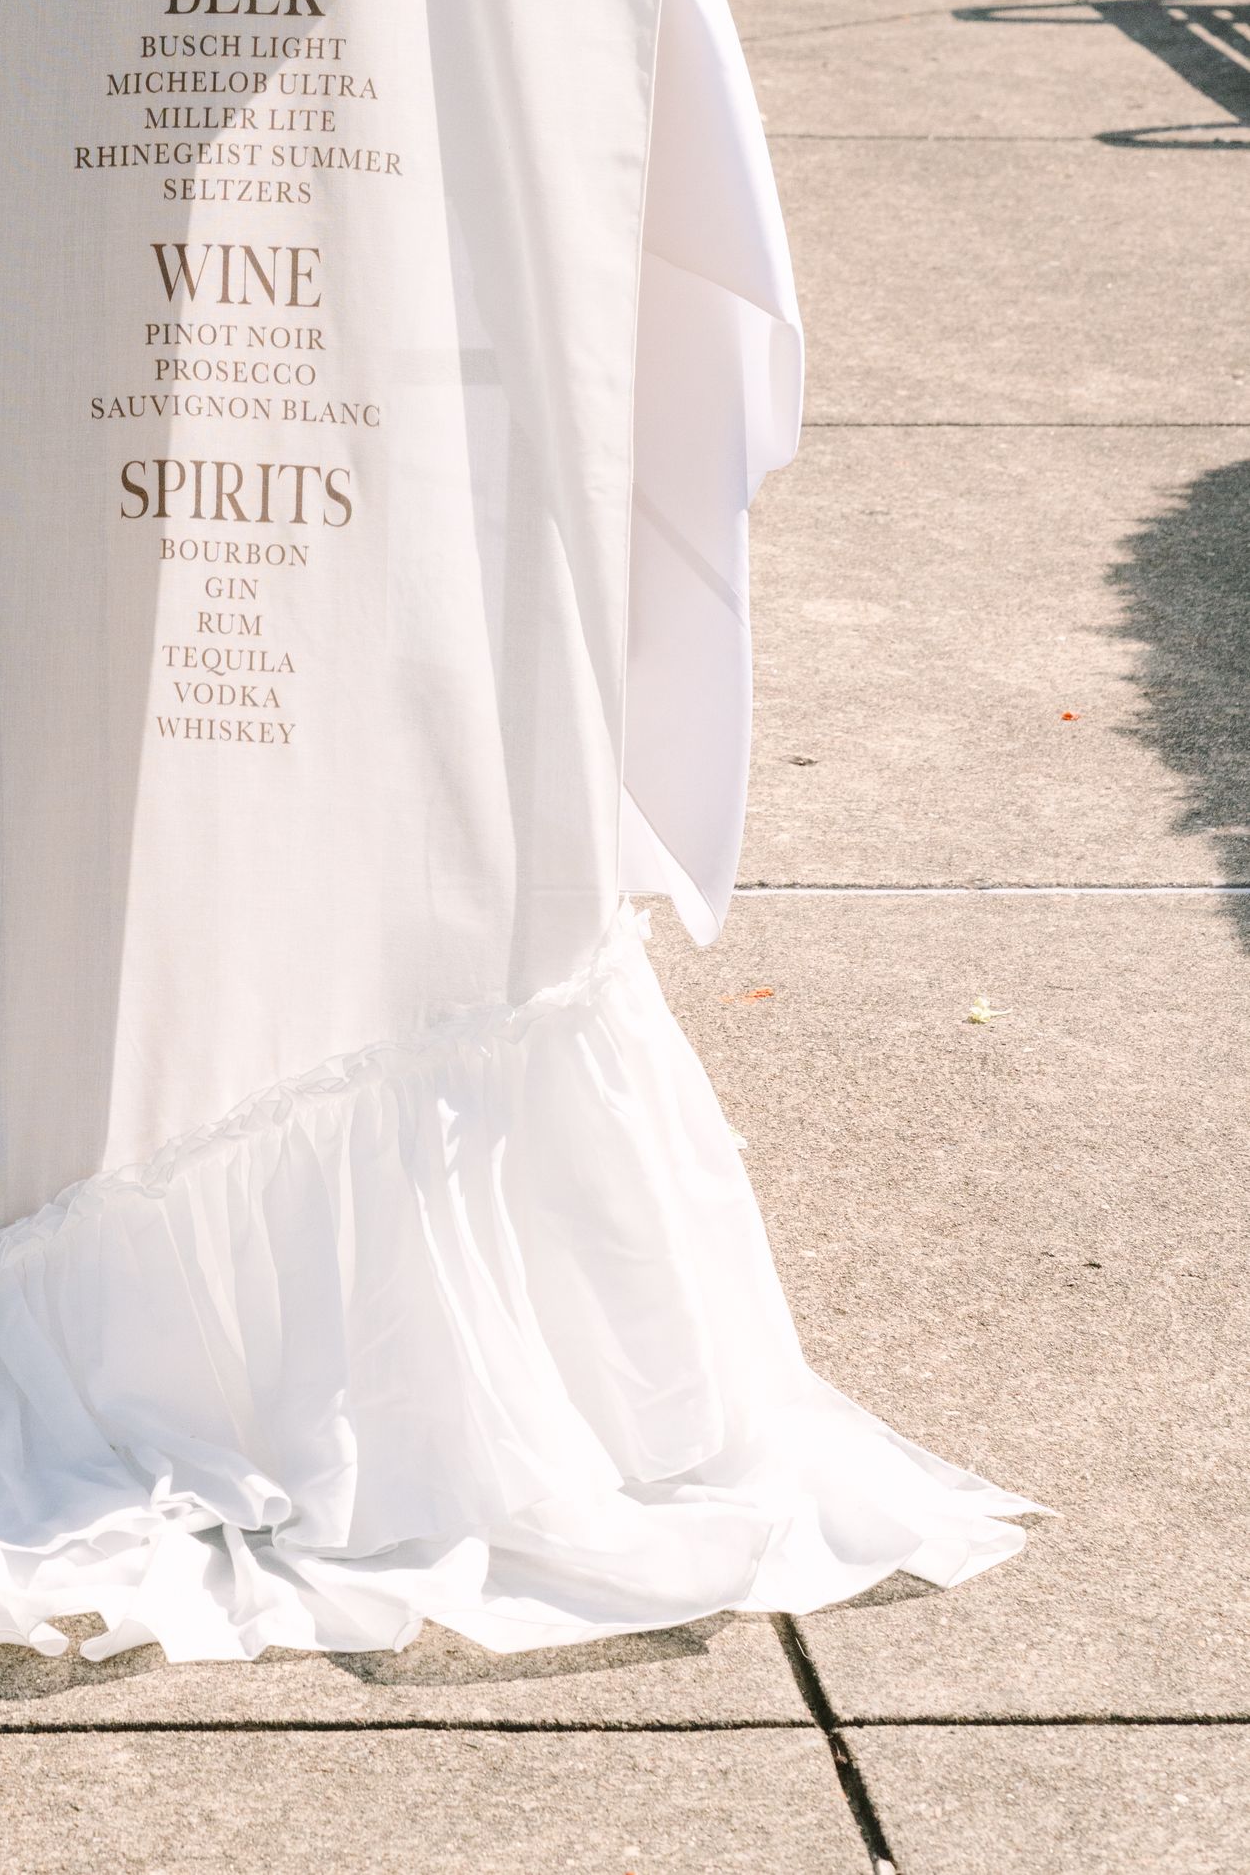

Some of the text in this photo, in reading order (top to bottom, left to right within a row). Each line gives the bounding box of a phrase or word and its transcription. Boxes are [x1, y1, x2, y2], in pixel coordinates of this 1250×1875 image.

[139, 33, 348, 63] BUSCH LIGHT
[105, 69, 379, 101] MICHELOB ULTRA
[143, 105, 337, 134] MILLER LITE
[73, 140, 404, 176] RHINEGEIST SUMMER
[163, 177, 313, 205] SELTZERS
[149, 242, 322, 308] WINE
[144, 322, 327, 352] PINOT NOIR
[154, 358, 317, 387] PROSECCO
[90, 393, 382, 429] SAUVIGNON BLANC
[120, 458, 354, 528] SPIRITS
[158, 537, 311, 567] BOURBON
[204, 576, 260, 601] GIN
[196, 611, 263, 637] RUM
[161, 644, 297, 677] TEQUILA
[172, 681, 282, 709] VODKA
[155, 716, 297, 745] WHISKEY
